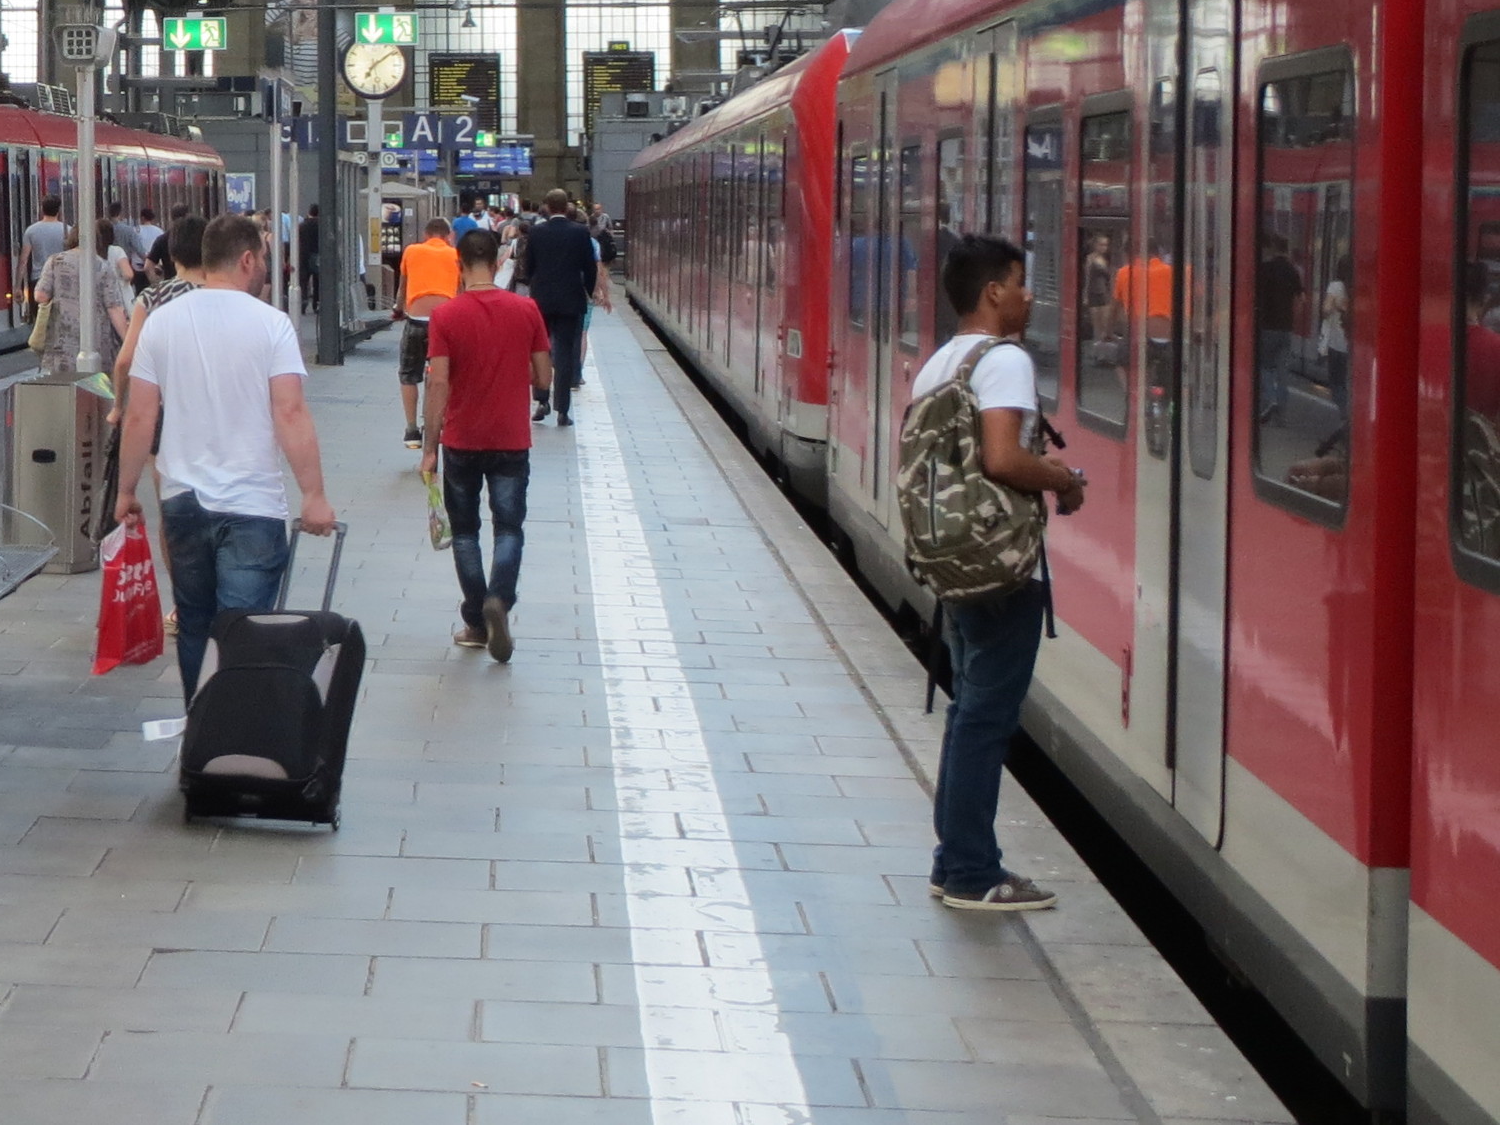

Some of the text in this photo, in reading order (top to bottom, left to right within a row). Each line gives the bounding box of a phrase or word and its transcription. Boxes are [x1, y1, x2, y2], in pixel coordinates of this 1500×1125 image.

[411, 116, 473, 142] A 2
[80, 440, 92, 539] Abfall
